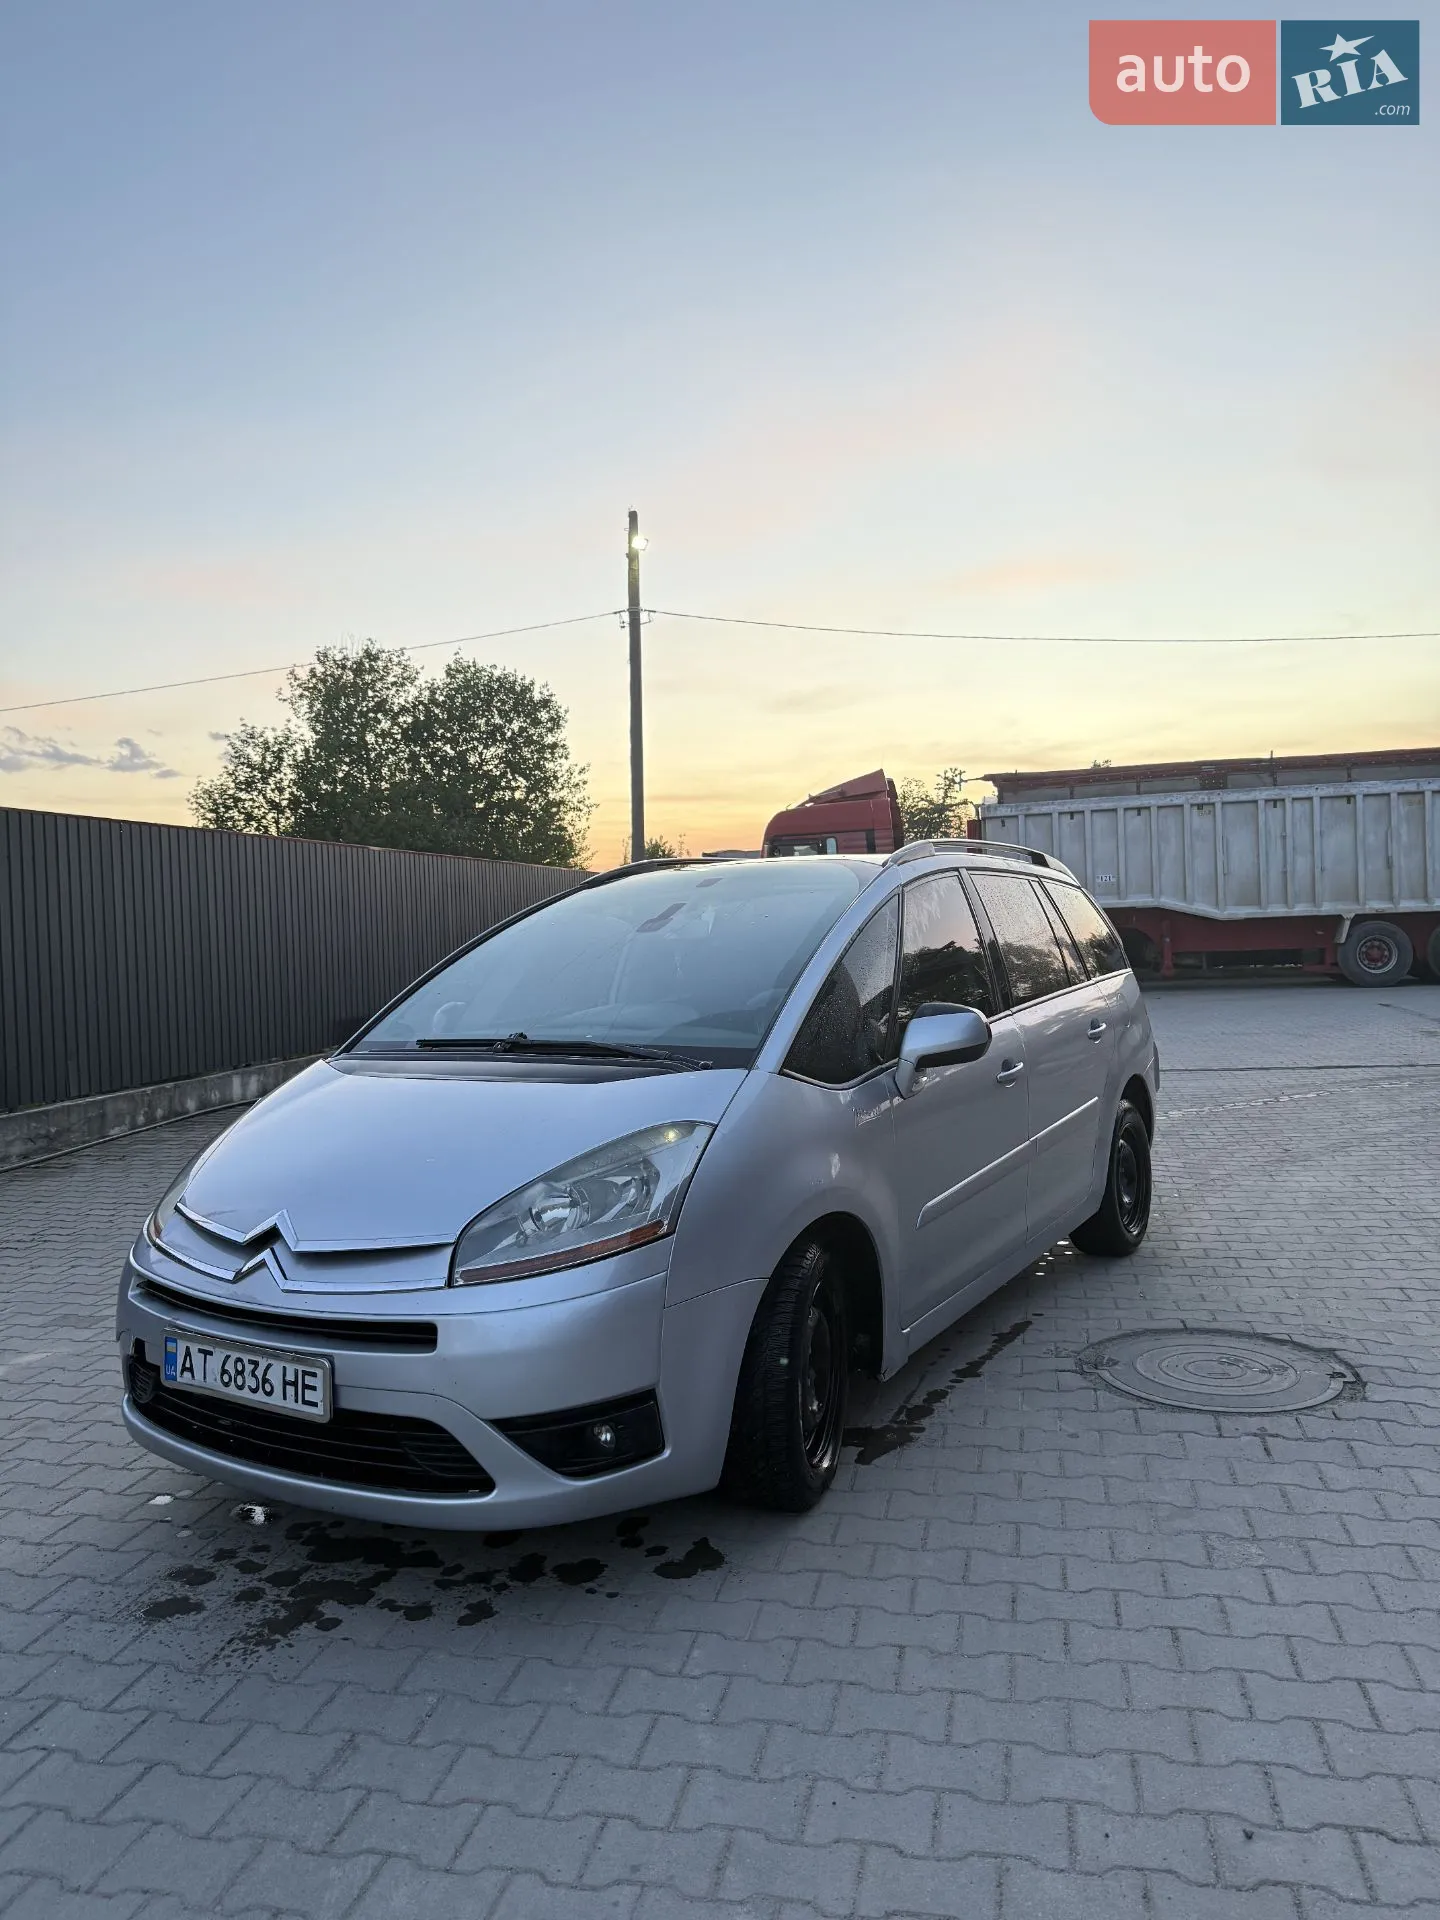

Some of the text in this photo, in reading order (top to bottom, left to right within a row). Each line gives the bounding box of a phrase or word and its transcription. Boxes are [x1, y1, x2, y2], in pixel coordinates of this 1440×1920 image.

[166, 1364, 177, 1376] UA
[179, 1345, 319, 1408] AT 6836 HE
